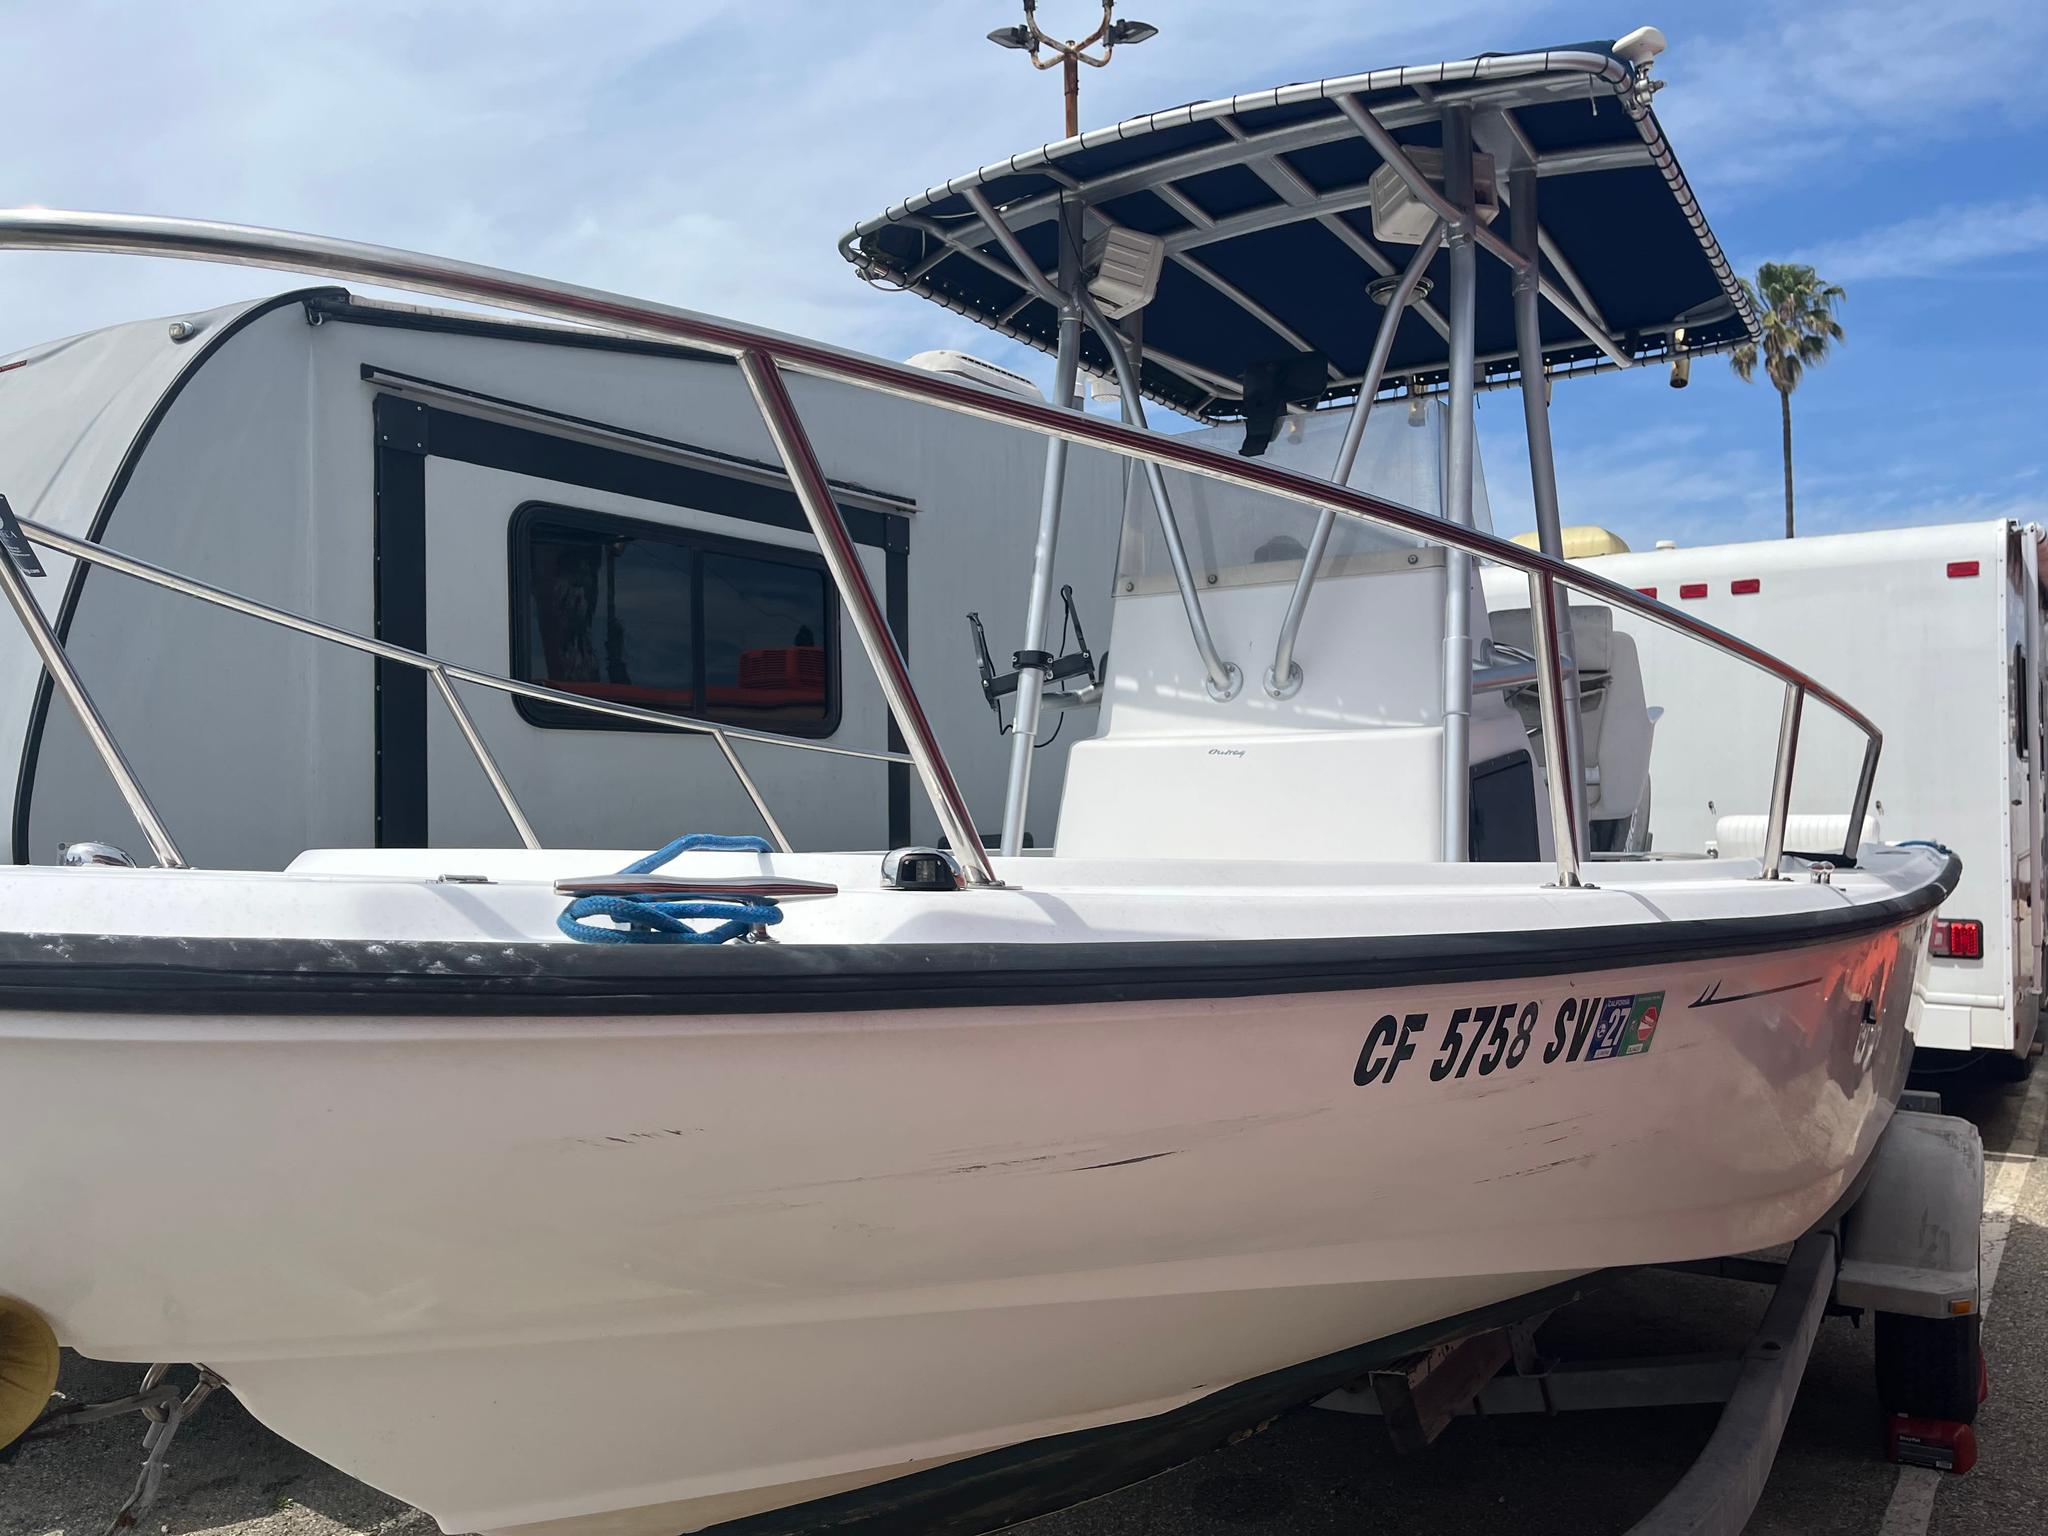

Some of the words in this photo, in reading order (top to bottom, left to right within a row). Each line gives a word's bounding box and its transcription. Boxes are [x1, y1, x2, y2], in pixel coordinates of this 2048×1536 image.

[1353, 1013, 1428, 1086] CF
[1429, 1001, 1539, 1082] 5758
[1543, 997, 1602, 1064] SV
[1601, 1007, 1632, 1048] 27
